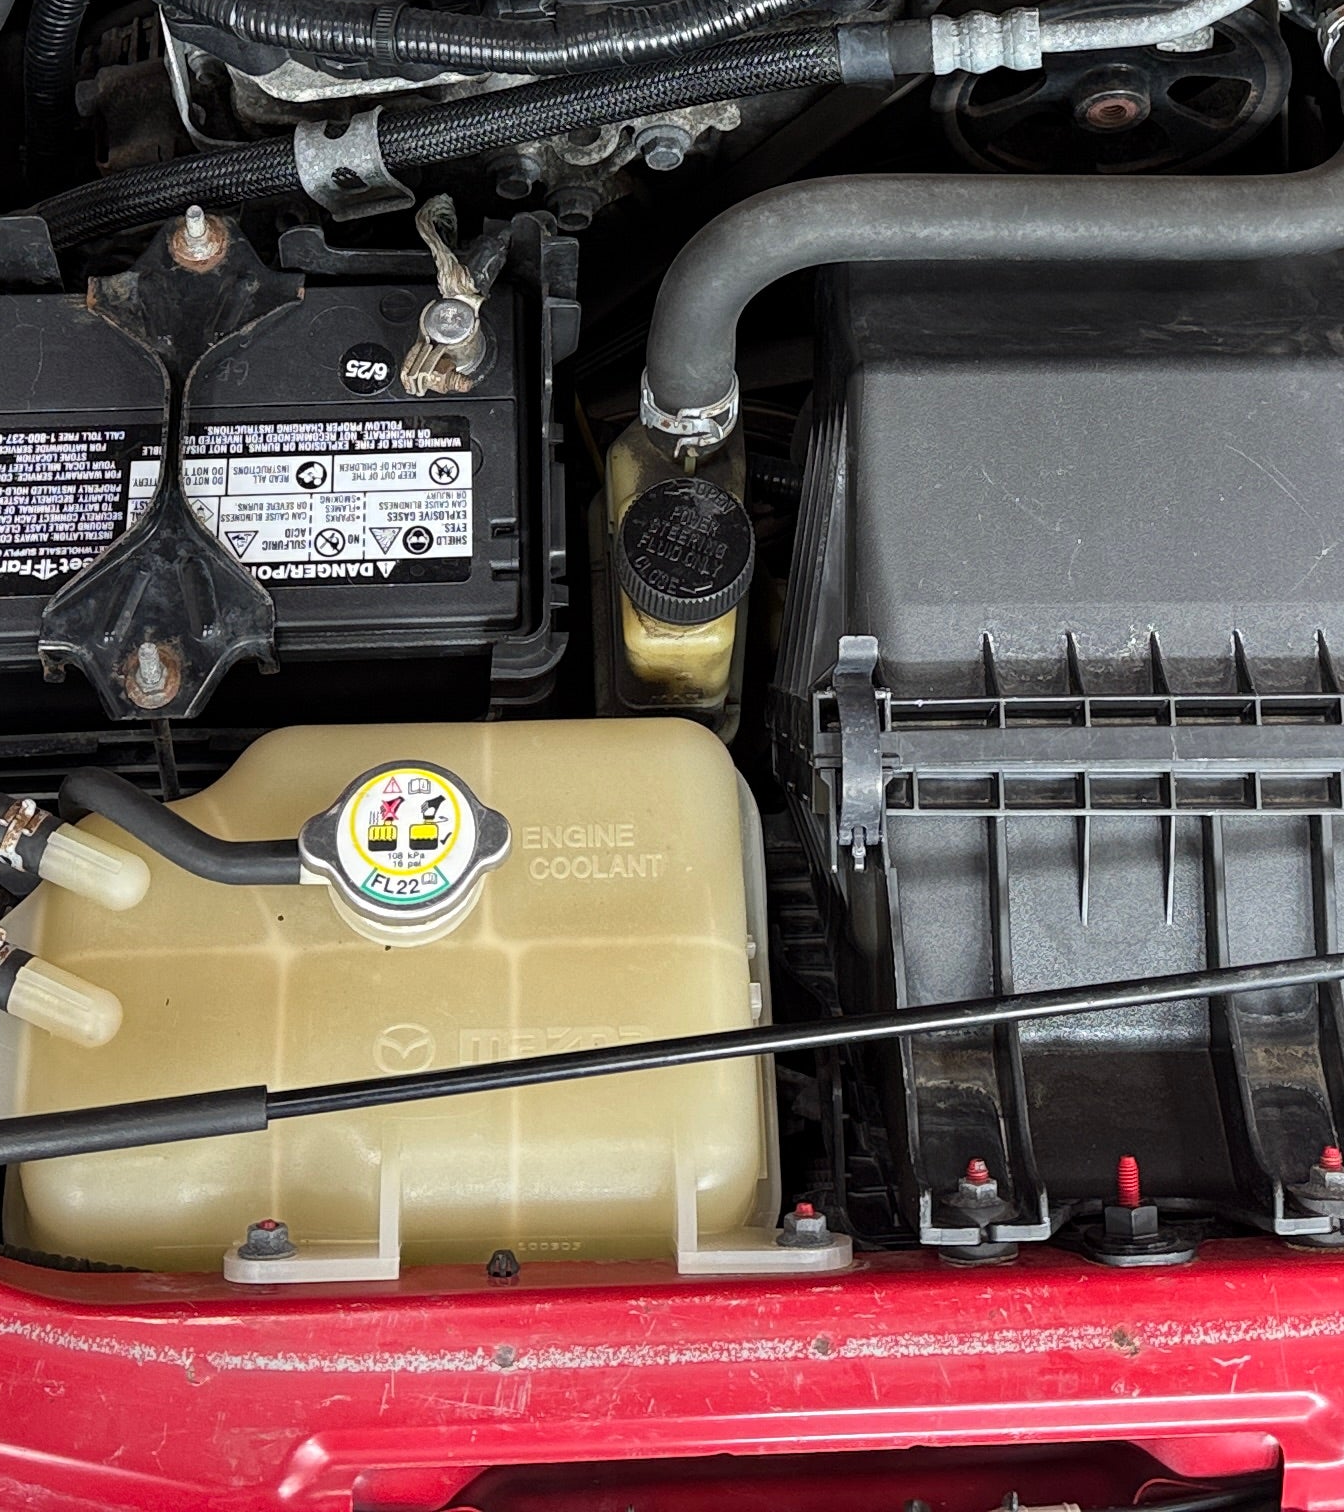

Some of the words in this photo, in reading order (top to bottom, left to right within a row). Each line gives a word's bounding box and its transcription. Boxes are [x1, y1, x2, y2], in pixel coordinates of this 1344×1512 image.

[345, 359, 388, 381] 6/25
[277, 423, 323, 434] CHARGING
[326, 422, 362, 432] PROPER
[364, 420, 402, 430] FOLLOW
[58, 432, 79, 442] FREE
[82, 432, 102, 441] TOLL
[104, 431, 125, 440] CALL
[266, 432, 336, 442] RECOMMENDED
[340, 431, 357, 440] NOT
[418, 429, 430, 438] OR
[198, 435, 243, 444] INVERTED
[245, 434, 263, 443] FOR
[35, 443, 87, 453] NATIONWIDE
[90, 443, 106, 452] FOR
[282, 443, 295, 452] OR
[298, 441, 349, 451] EXPLOSION
[377, 439, 389, 449] OF
[391, 439, 413, 448] RISK
[209, 445, 227, 454] NOT
[229, 444, 243, 454] DO
[60, 452, 87, 461] STORE
[8, 463, 33, 473] FLEET
[36, 463, 61, 472] MILLS
[64, 462, 89, 471] LOCAL
[91, 461, 115, 470] YOUR
[379, 462, 388, 470] OF
[391, 462, 416, 470] REACH
[55, 471, 102, 481] WARRANTY
[104, 470, 121, 479] FOR
[191, 467, 209, 476] NOT
[212, 467, 223, 476] DO
[368, 472, 378, 480] OF
[381, 472, 395, 480] OUT
[398, 471, 416, 480] KEEP
[193, 477, 209, 485] NOT
[212, 477, 223, 485] DO
[253, 476, 266, 484] ALL
[269, 474, 289, 482] READ
[352, 473, 366, 481] THE
[31, 485, 76, 495] INSTALLED
[78, 484, 121, 493] PROPERLY
[31, 494, 74, 504] SECURELY
[457, 491, 466, 499] OR
[696, 481, 737, 514] OPEN
[18, 504, 60, 513] TERMINAL
[62, 503, 99, 512] BATTERY
[102, 502, 112, 511] TO
[266, 502, 294, 511] SEVERE
[297, 502, 307, 510] OR
[379, 501, 421, 510] BLINDNESS
[425, 501, 449, 509] CAUSE
[452, 500, 467, 508] CAN
[4, 505, 15, 514] OF
[14, 514, 37, 523] EACH
[40, 513, 78, 522] CONNECT
[80, 512, 123, 521] SECURELY
[220, 513, 262, 523] BLINDNESS
[265, 513, 289, 521] CAUSE
[292, 512, 306, 520] CAN
[387, 512, 415, 522] GASES
[419, 510, 466, 521] EXPLOSIVE
[670, 505, 720, 536] POWER
[49, 523, 75, 532] CABLE
[78, 521, 114, 531] GROUND
[14, 533, 49, 542] ALWAYS
[285, 528, 306, 538] ACID
[348, 534, 359, 544] NO
[437, 535, 467, 545] SHIELD
[648, 517, 728, 559] STEERING
[262, 540, 306, 550] SULFURIC
[5, 547, 37, 557] SUPPLY
[39, 546, 93, 556] WHOLESALE
[637, 533, 682, 562] FLUID
[683, 549, 724, 578] ONLY
[634, 555, 681, 595] CLOSE
[522, 823, 636, 849] ENGINE
[407, 860, 422, 869] psi
[529, 853, 663, 880] COOLANT
[370, 873, 421, 895] FL22
